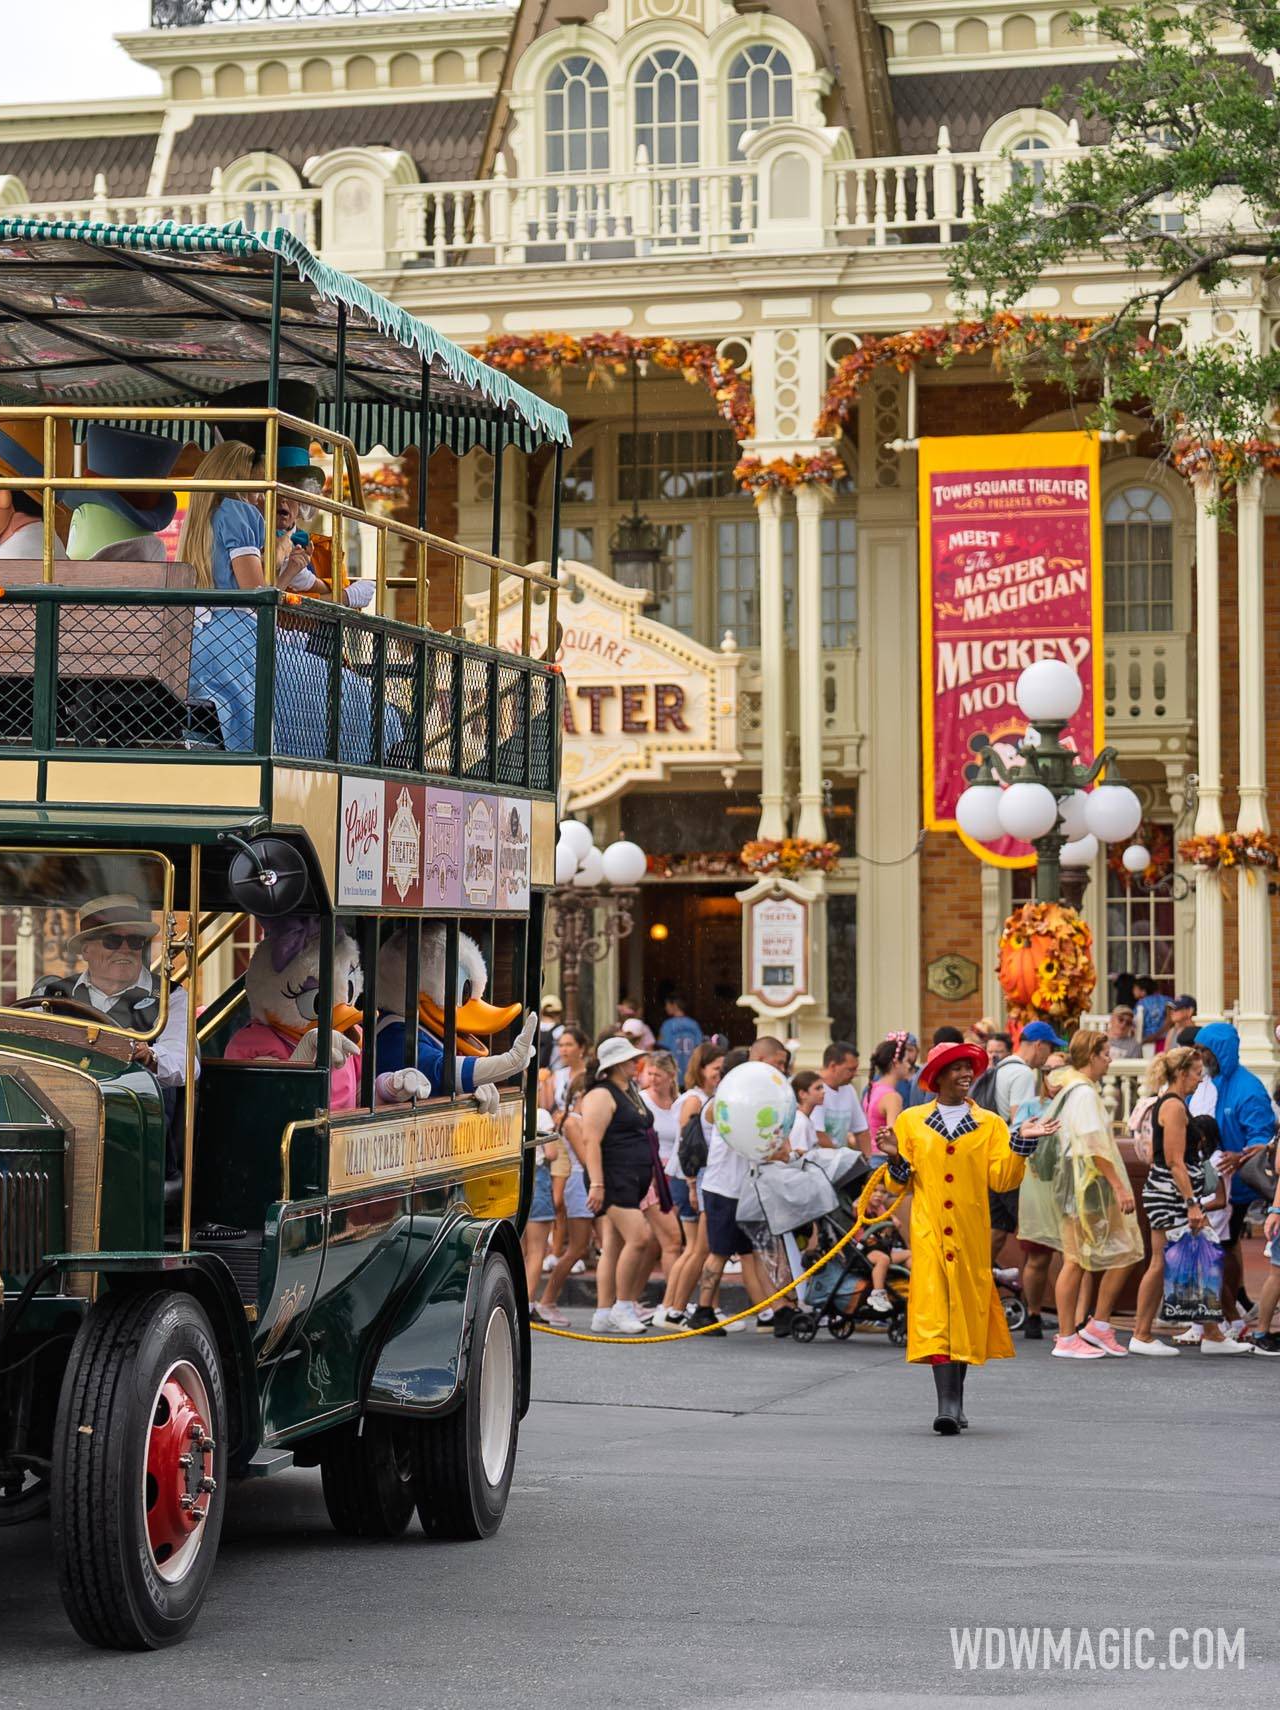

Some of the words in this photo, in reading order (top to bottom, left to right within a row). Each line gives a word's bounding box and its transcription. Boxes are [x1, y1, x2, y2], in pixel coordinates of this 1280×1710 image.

[932, 483, 973, 507] TOWN
[973, 479, 1026, 497] SQUARE
[1027, 478, 1088, 501] THEATER
[987, 497, 1033, 510] PRESENTS
[948, 530, 1001, 549] MEET
[954, 555, 1047, 598] MASTER
[962, 567, 1088, 623] MAGICIAN
[557, 628, 632, 667] QUARE
[936, 636, 1090, 695] MICKEY
[355, 866, 374, 882] CORNER
[345, 1137, 370, 1177] MAIN
[372, 1132, 407, 1172] STREET
[409, 1120, 479, 1166] TRANSPORTATION
[478, 1113, 513, 1152] COMPANY
[1164, 1302, 1198, 1319] Disney
